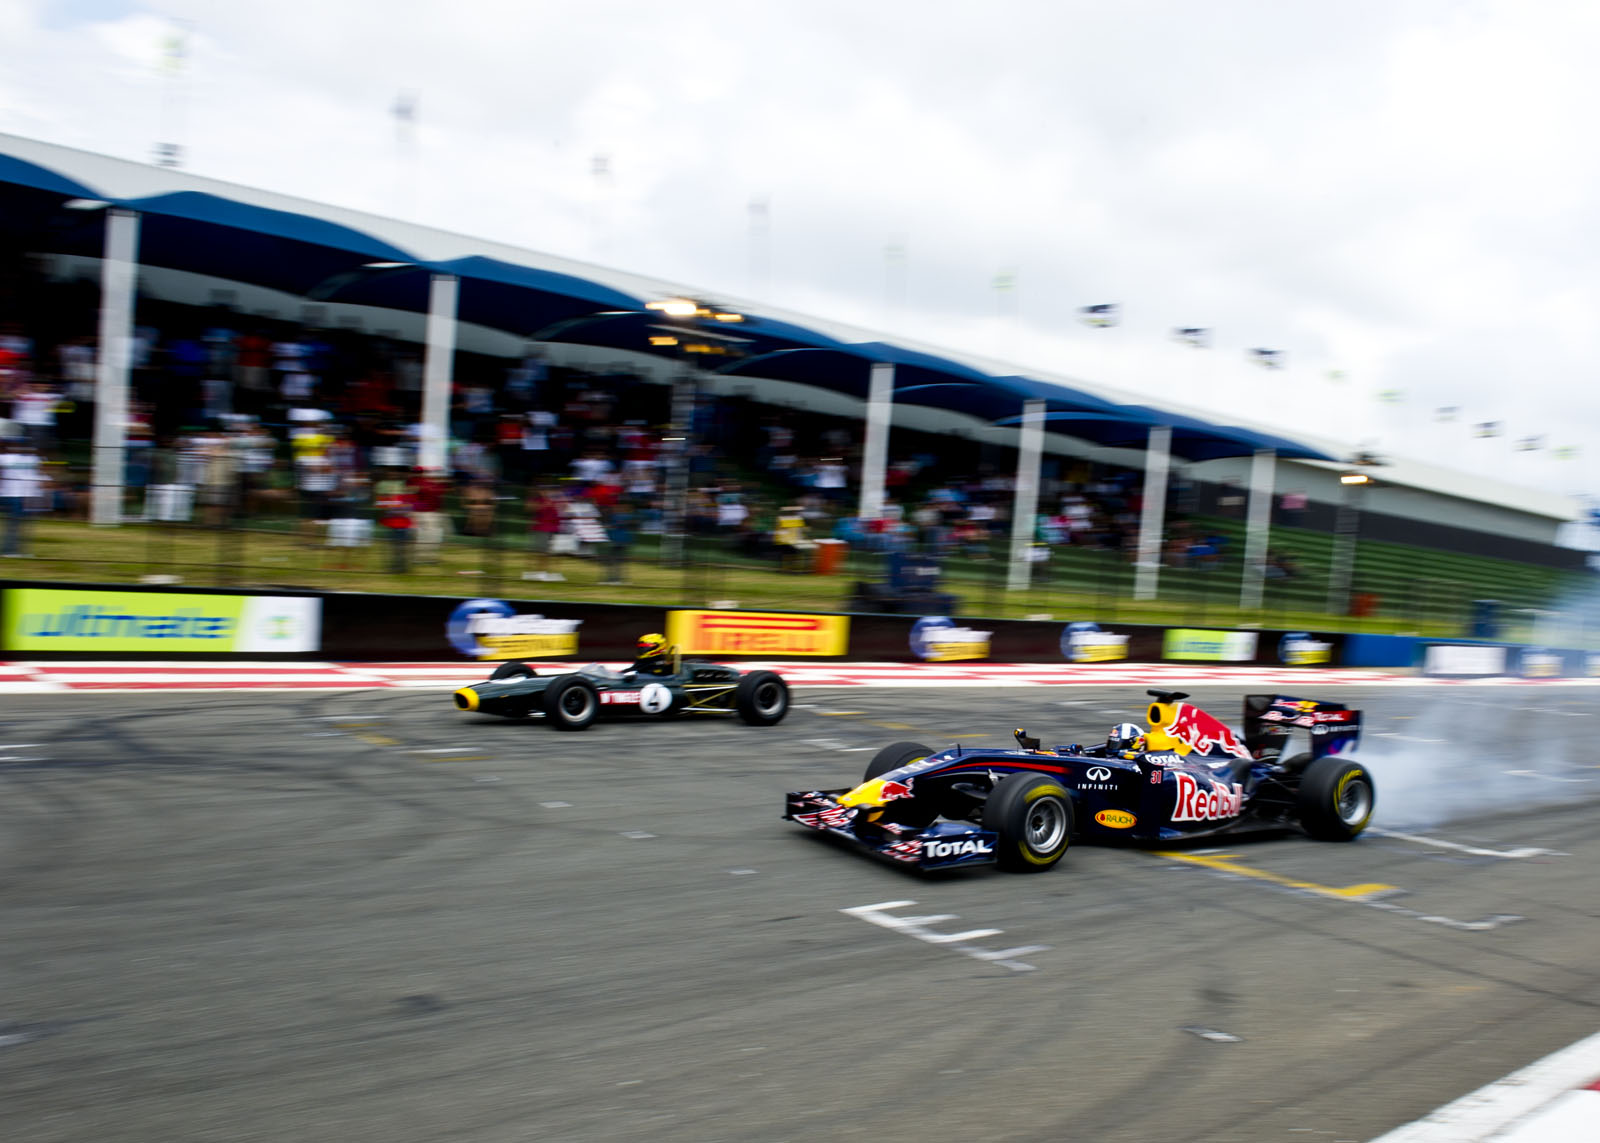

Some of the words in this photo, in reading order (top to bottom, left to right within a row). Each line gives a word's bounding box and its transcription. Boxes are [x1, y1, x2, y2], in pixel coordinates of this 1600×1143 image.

[1144, 754, 1185, 766] TOTAL
[1150, 770, 1162, 785] 31
[1077, 783, 1118, 791] INFINITI
[1106, 814, 1133, 825] RAUCH
[923, 839, 993, 858] TOTAL
